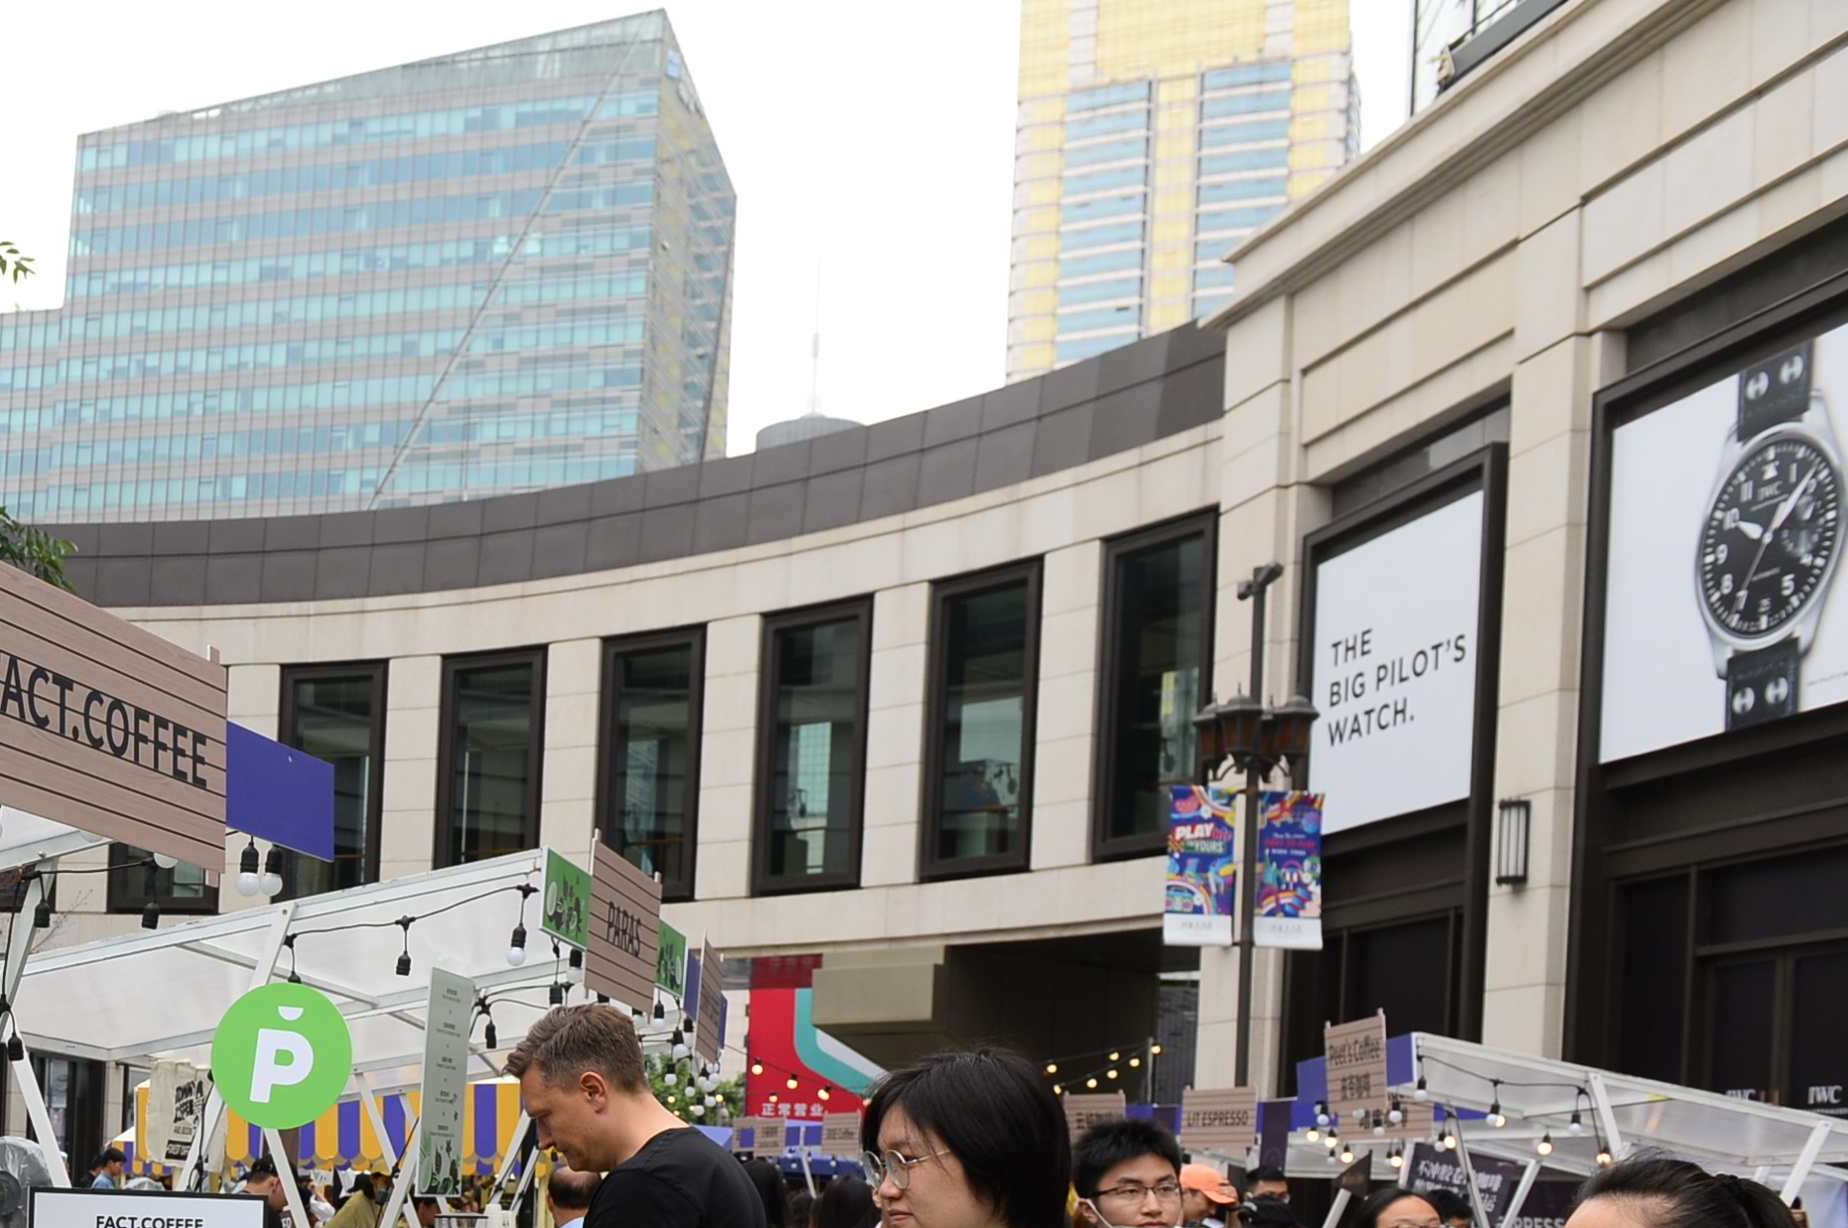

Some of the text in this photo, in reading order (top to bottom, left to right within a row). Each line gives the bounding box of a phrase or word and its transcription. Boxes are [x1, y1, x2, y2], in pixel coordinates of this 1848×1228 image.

[1331, 627, 1373, 668] THE
[1329, 633, 1467, 708] BIG PILOT'S
[1328, 697, 1415, 747] WATCH.
[1175, 822, 1216, 841] PLAY
[607, 901, 642, 959] PARAS
[761, 1102, 824, 1117] 正常营业
[1807, 1085, 1842, 1105] IWC
[1202, 1110, 1249, 1127] ESPRESSO
